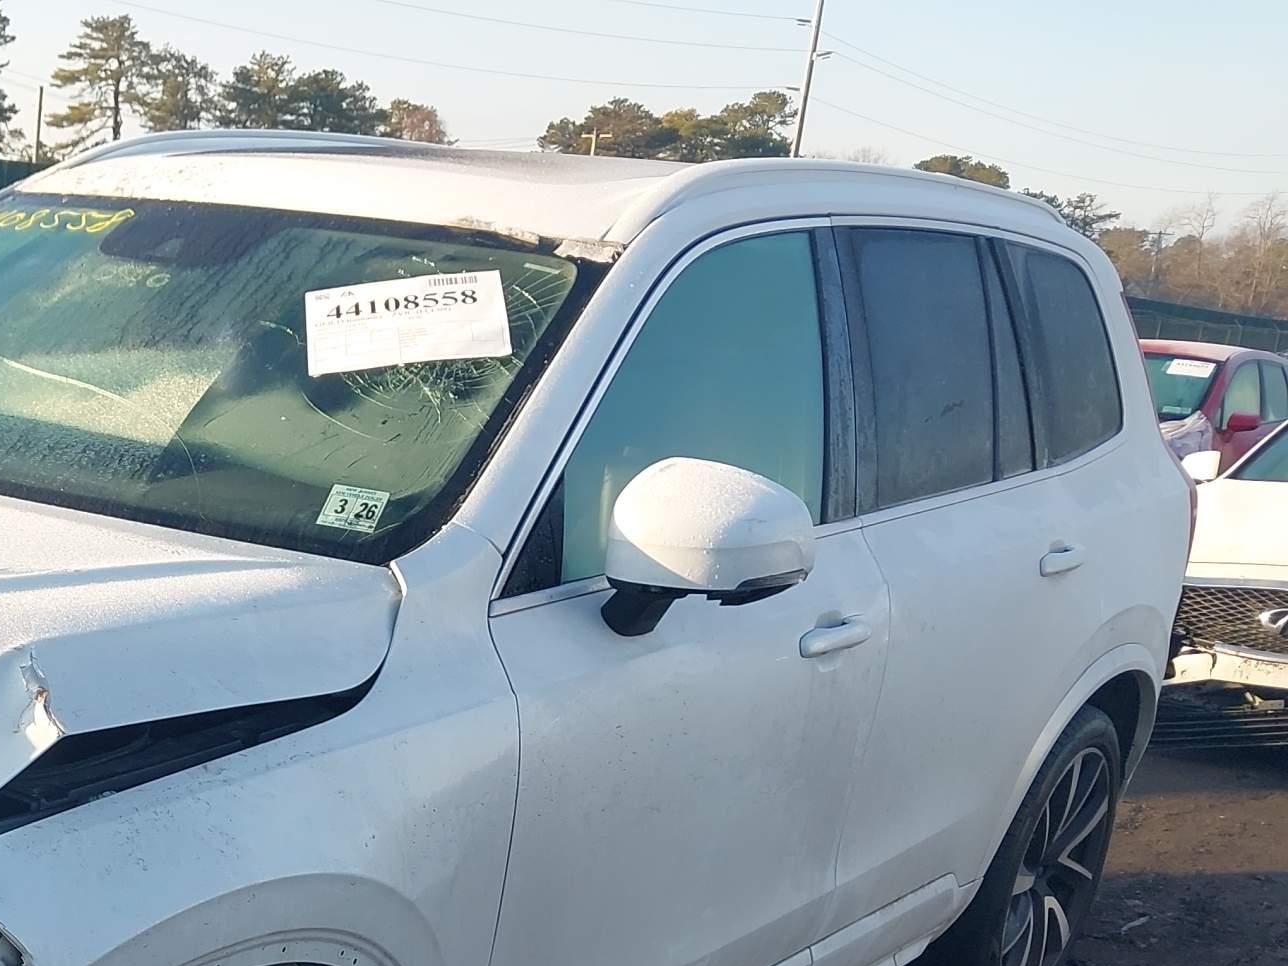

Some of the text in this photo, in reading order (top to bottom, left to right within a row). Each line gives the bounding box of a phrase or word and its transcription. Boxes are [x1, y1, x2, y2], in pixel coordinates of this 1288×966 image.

[326, 289, 478, 319] 44108558
[334, 498, 378, 521] 3 26
